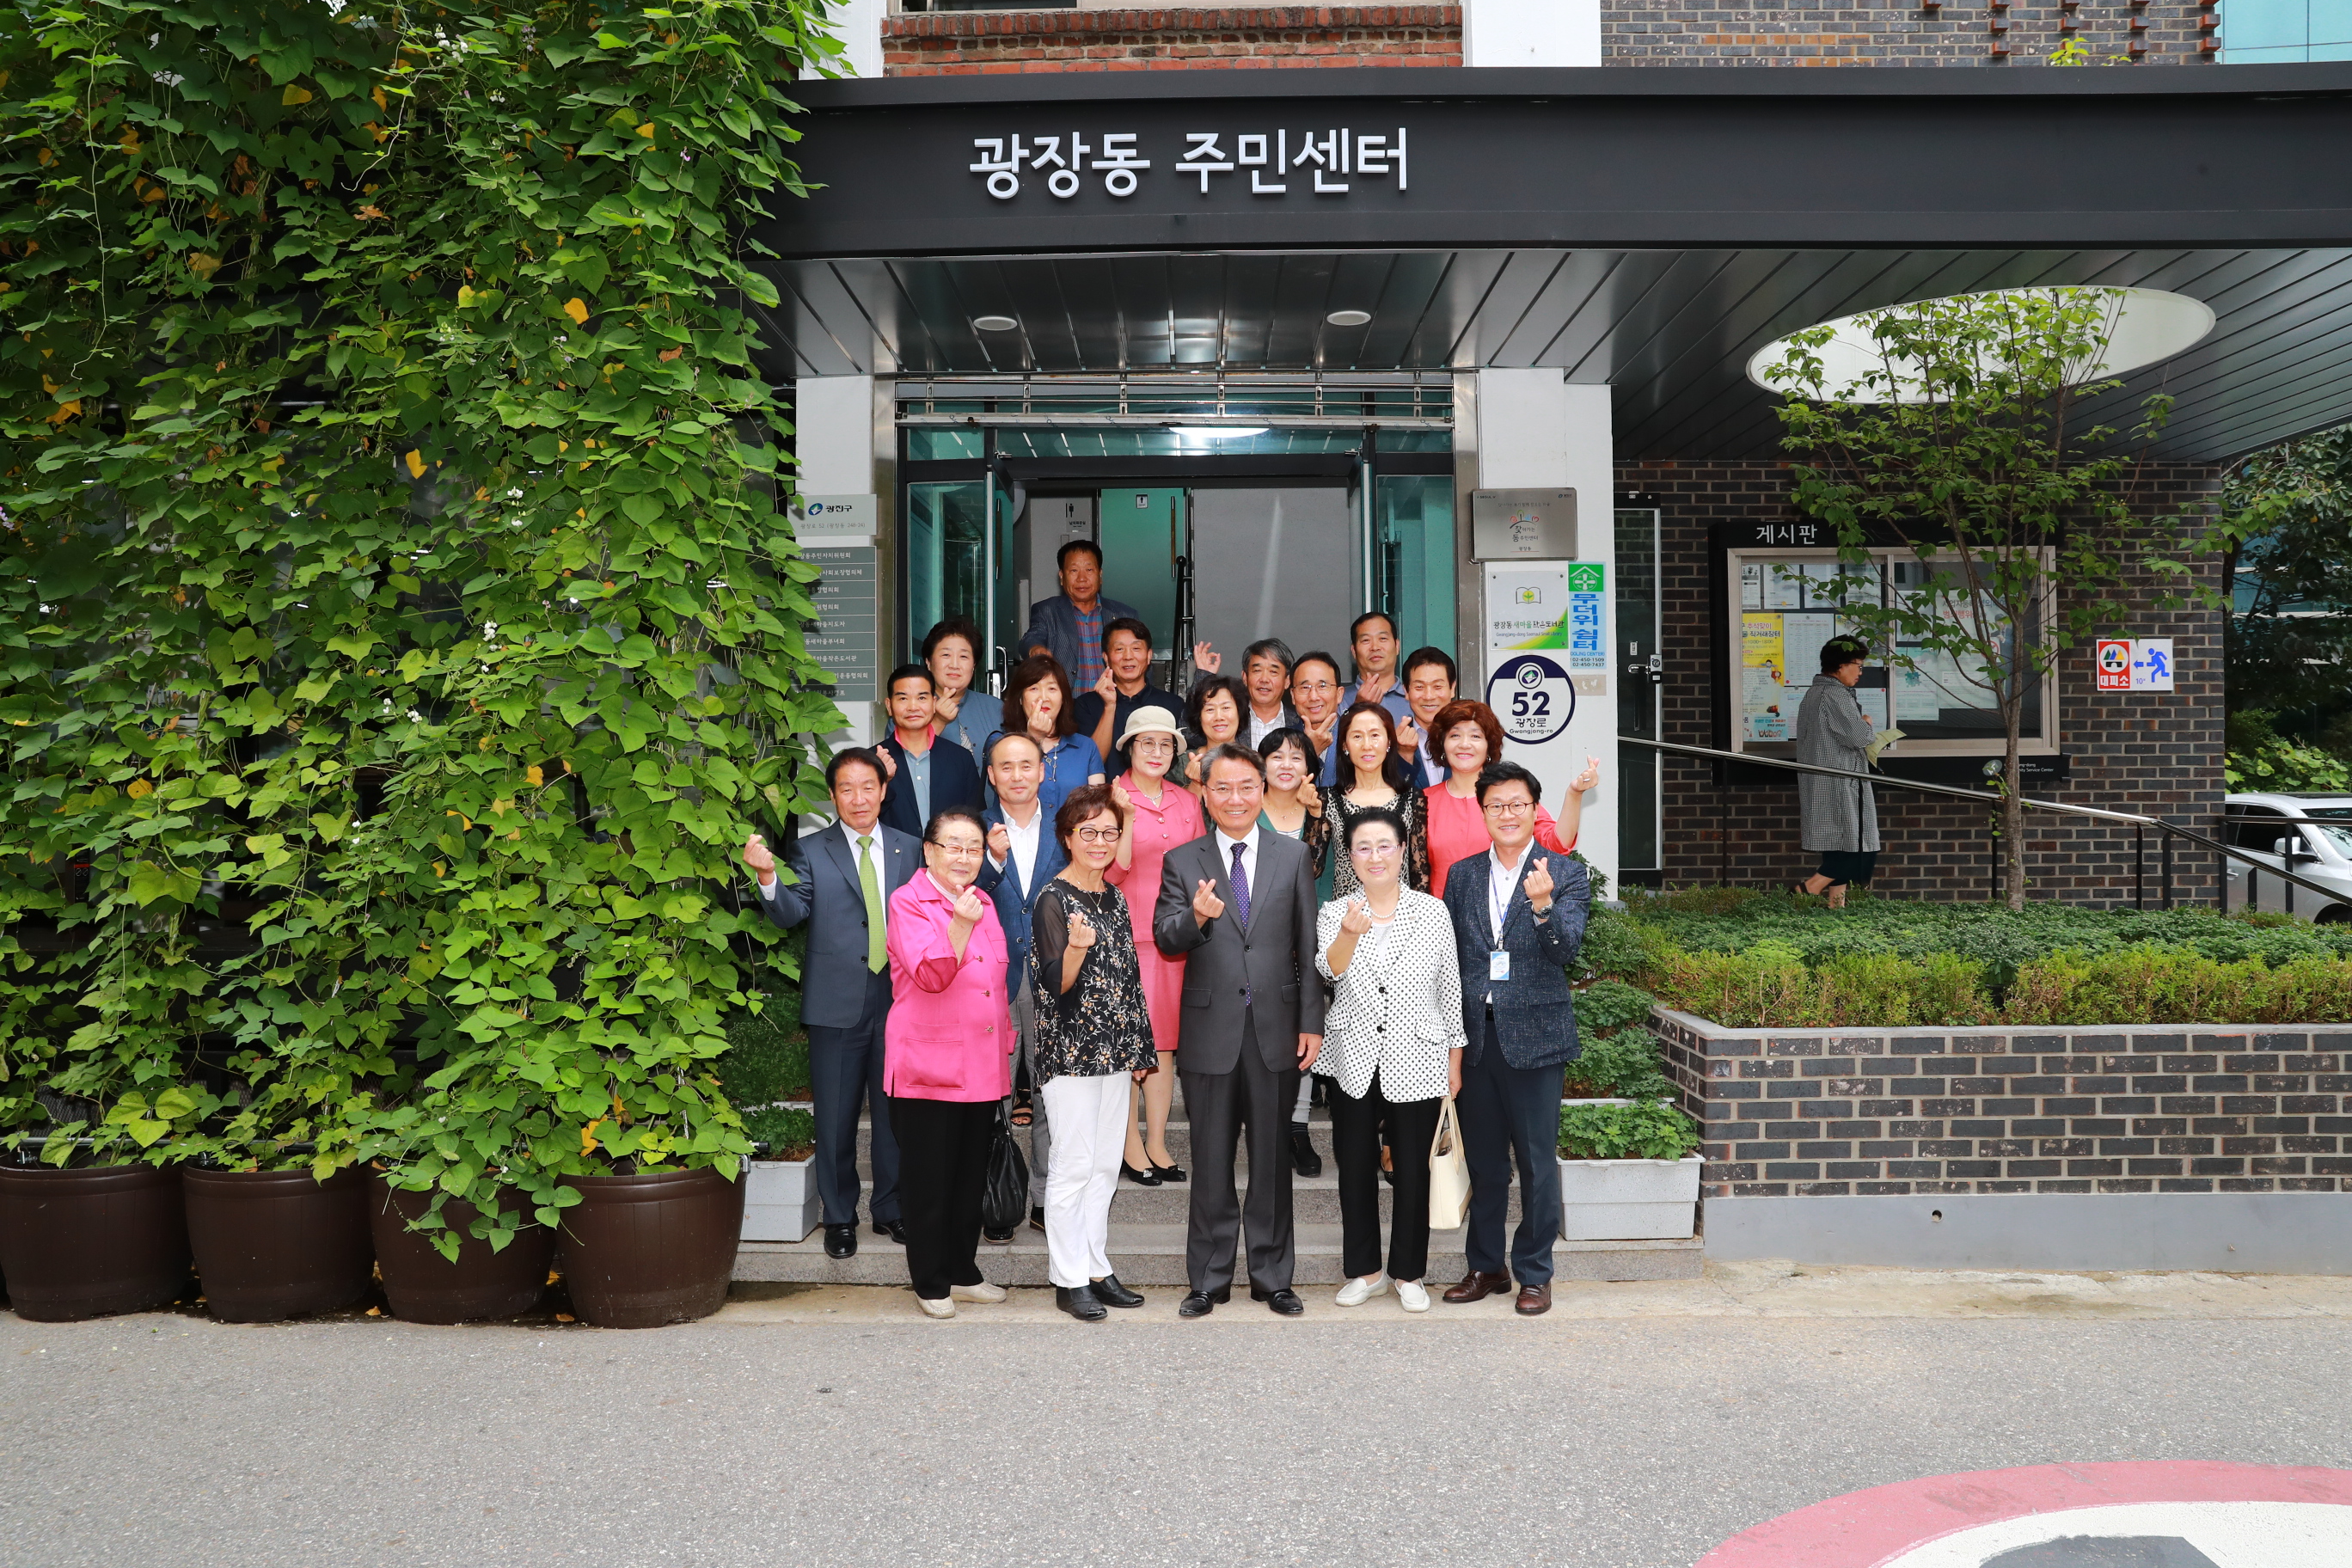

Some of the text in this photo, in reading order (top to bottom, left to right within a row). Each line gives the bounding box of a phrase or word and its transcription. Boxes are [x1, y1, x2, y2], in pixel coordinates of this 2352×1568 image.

[970, 128, 1407, 199] 광장동 주민센터
[1756, 524, 1818, 545] 게시판
[1493, 620, 1565, 629] 광장동 새마을 작은도서관
[1571, 593, 1599, 651] 무더위 쉼터
[2099, 675, 2129, 686] 대피소
[1511, 690, 1551, 717] 52
[1516, 718, 1547, 728] 광장로
